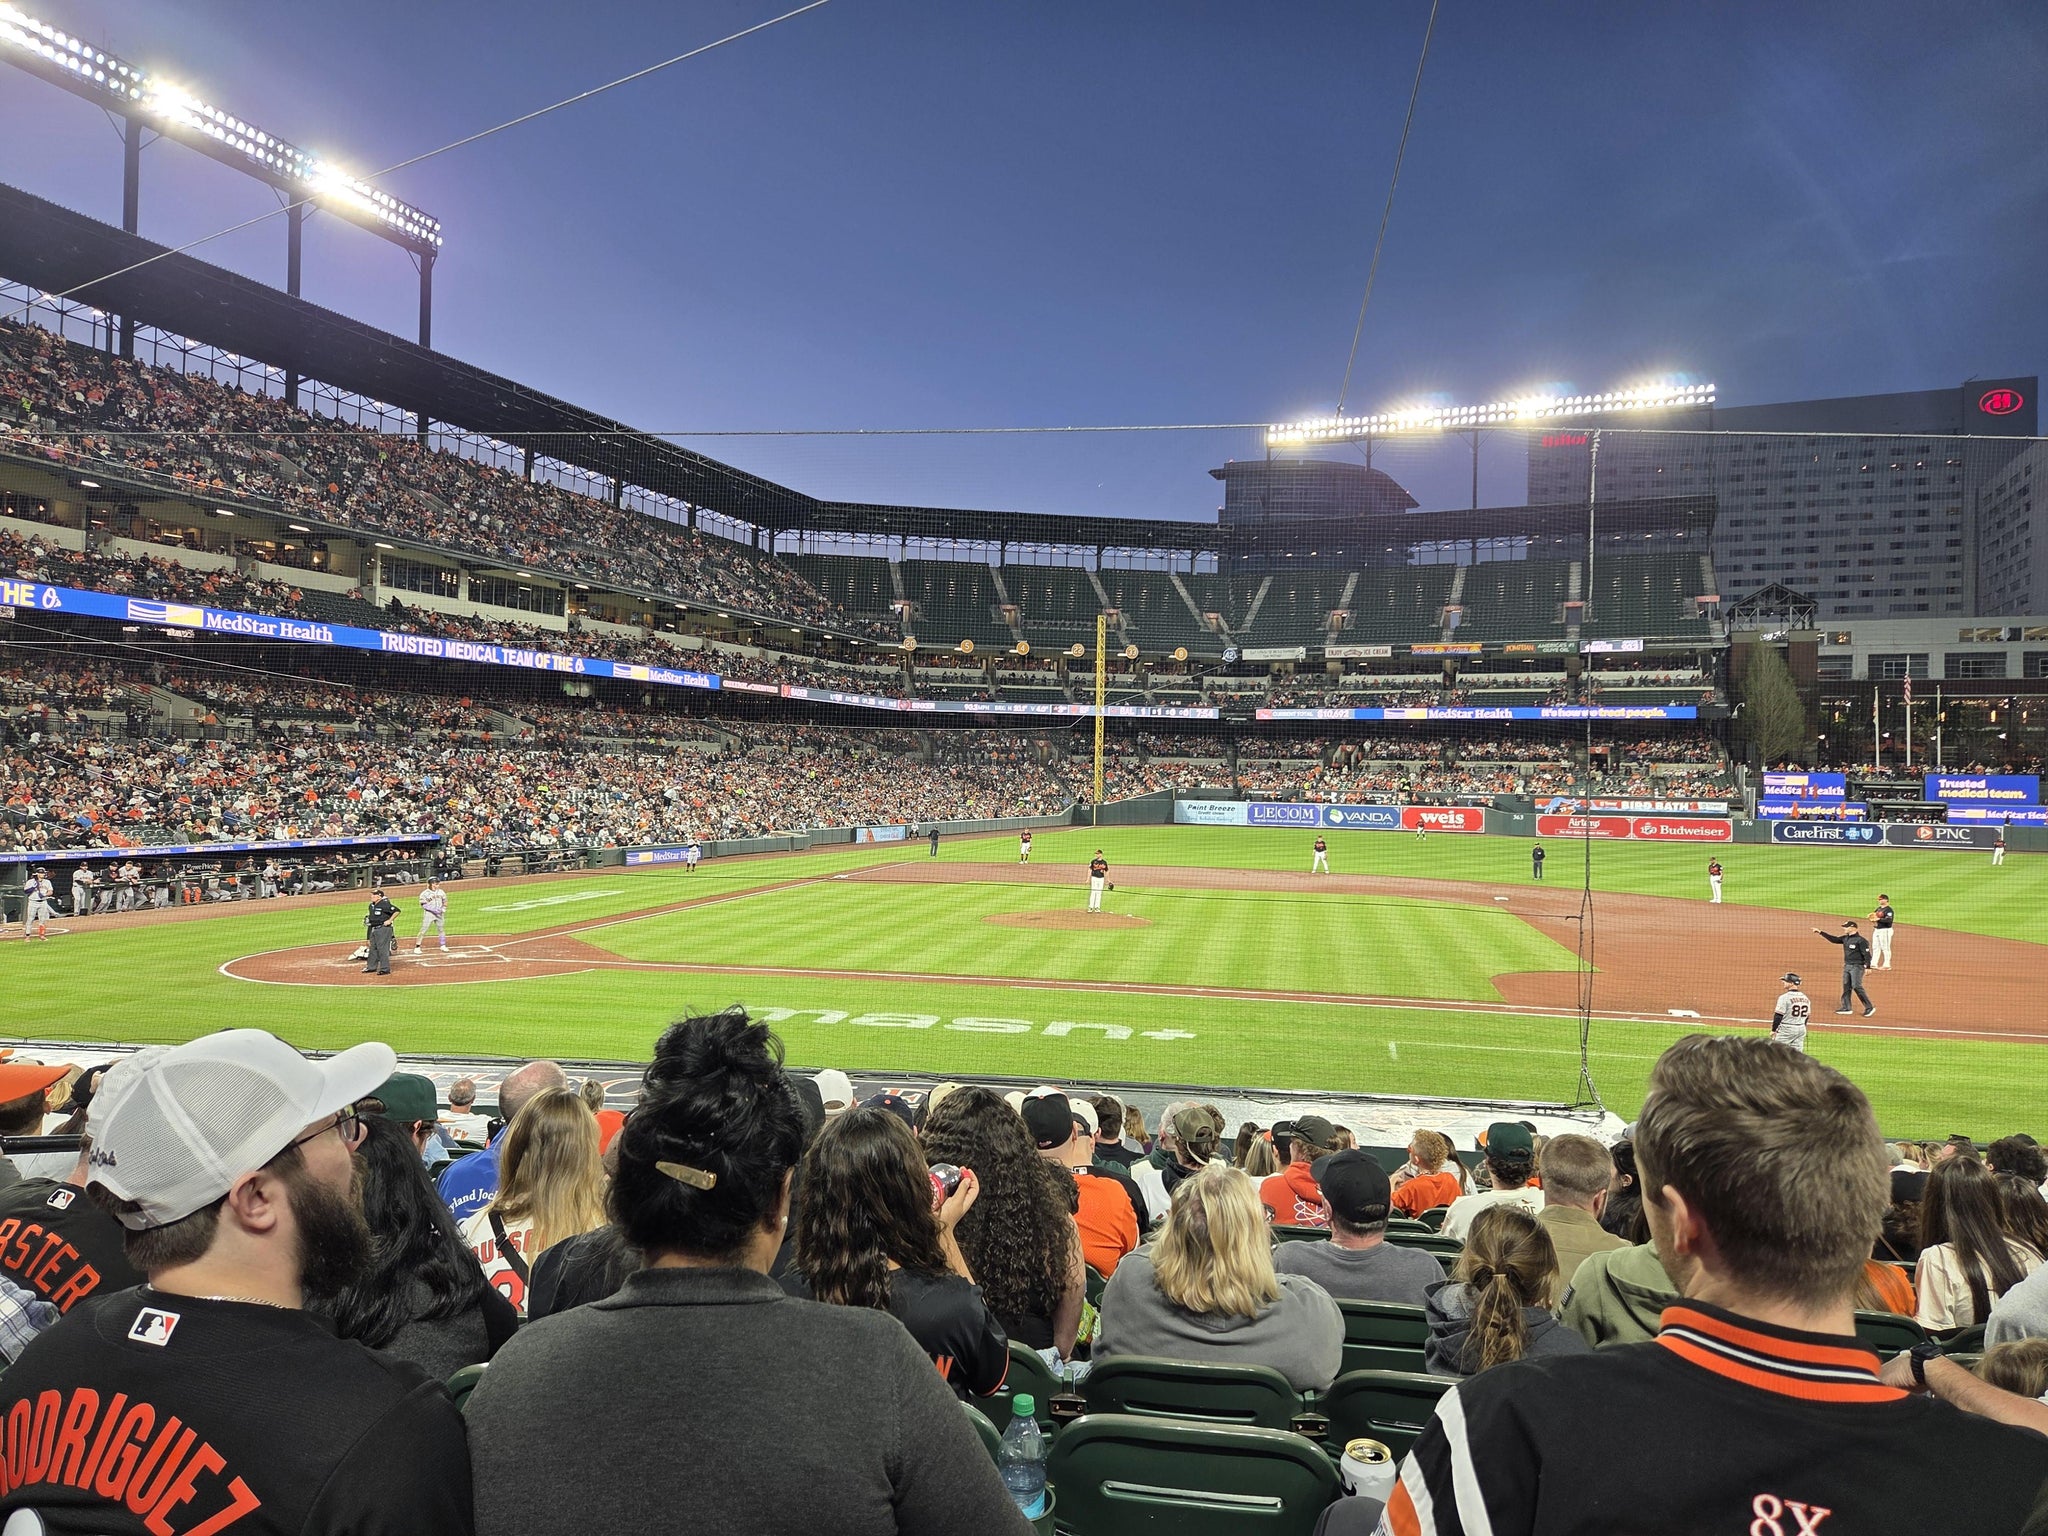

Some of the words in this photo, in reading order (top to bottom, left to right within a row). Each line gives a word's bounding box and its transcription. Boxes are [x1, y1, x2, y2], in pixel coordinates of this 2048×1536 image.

[206, 612, 277, 635] MedStar
[279, 622, 334, 643] Health
[380, 632, 442, 656] TRUSTED
[446, 641, 500, 664] MEDICAL
[502, 647, 533, 667] TEAM
[535, 652, 550, 669] OF
[552, 654, 574, 673] THE
[1364, 648, 1373, 656] ICE
[1373, 648, 1388, 656] CREAM
[649, 669, 683, 685] MedStar
[684, 672, 710, 688] Health
[1428, 708, 1474, 719] MedStar
[1474, 708, 1513, 719] Health
[1598, 707, 1625, 717] treat
[1937, 779, 1986, 789] Trusted
[1938, 788, 1989, 798] medical
[1989, 789, 2027, 799] team.
[1208, 804, 1236, 812] Breeze
[1620, 801, 1652, 811] BIRD
[1652, 801, 1691, 811] BATH
[1757, 805, 1795, 816] Trusted
[1798, 805, 1836, 815] medical
[1343, 811, 1394, 822] VANDA
[1420, 810, 1465, 825] weis
[1783, 825, 1844, 840] CareFirst
[1936, 828, 1970, 840] PNC
[653, 850, 679, 861] MedStar
[1791, 1004, 1809, 1018] 82
